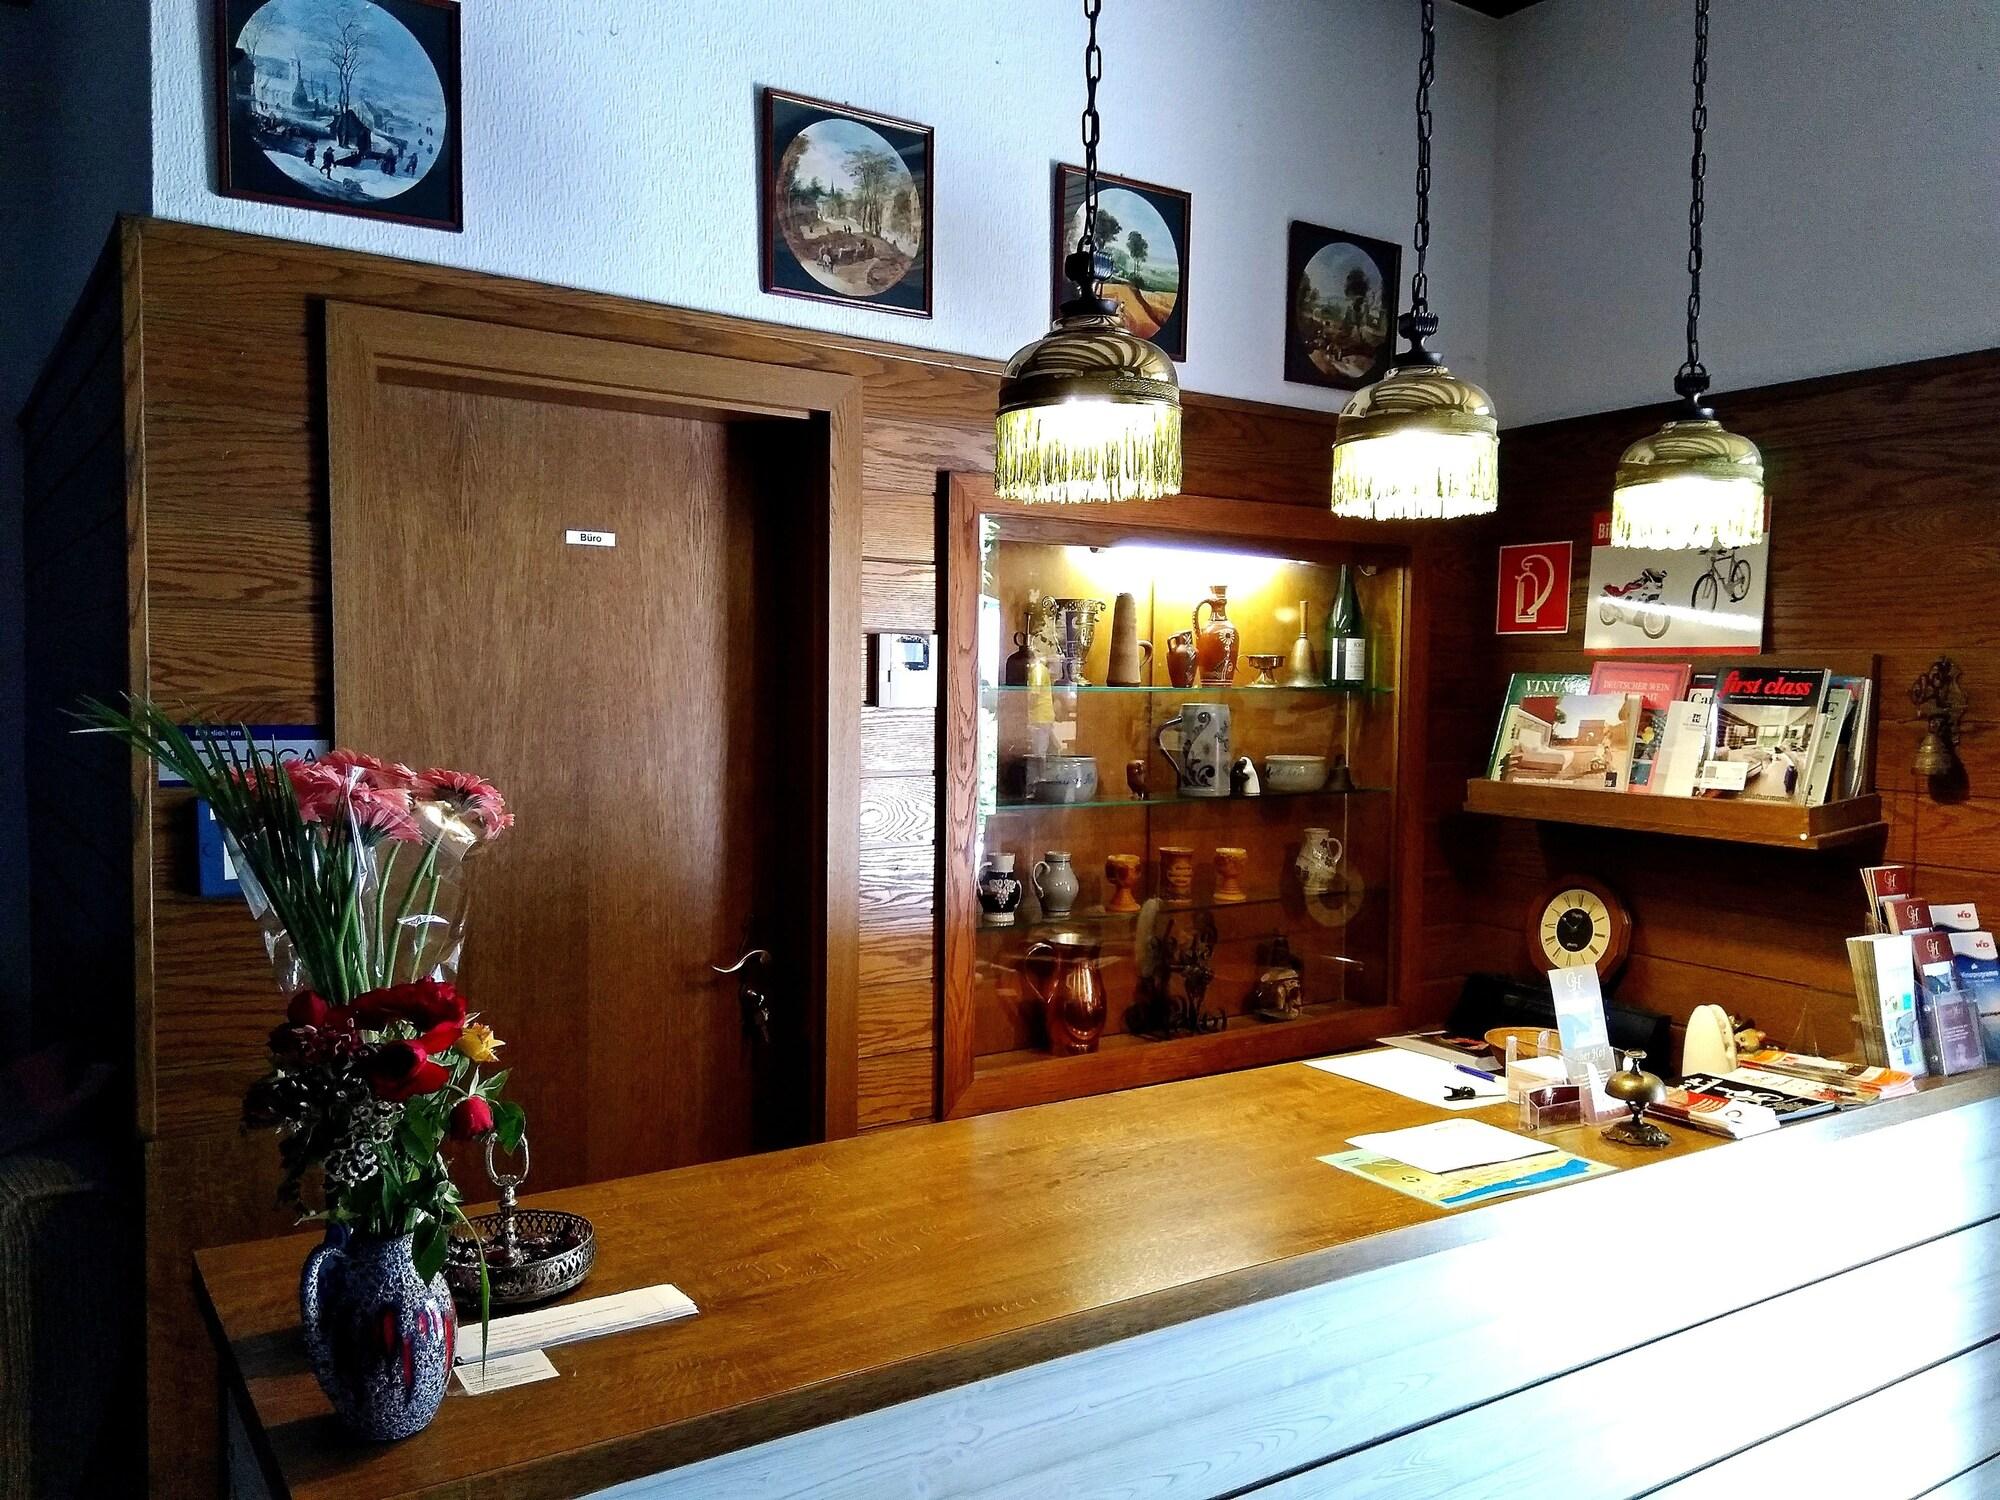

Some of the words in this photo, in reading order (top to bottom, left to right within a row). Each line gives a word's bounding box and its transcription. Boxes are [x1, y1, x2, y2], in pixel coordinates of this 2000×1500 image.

[580, 533, 602, 542] Büro
[1717, 669, 1763, 699] first
[1763, 676, 1813, 696] class
